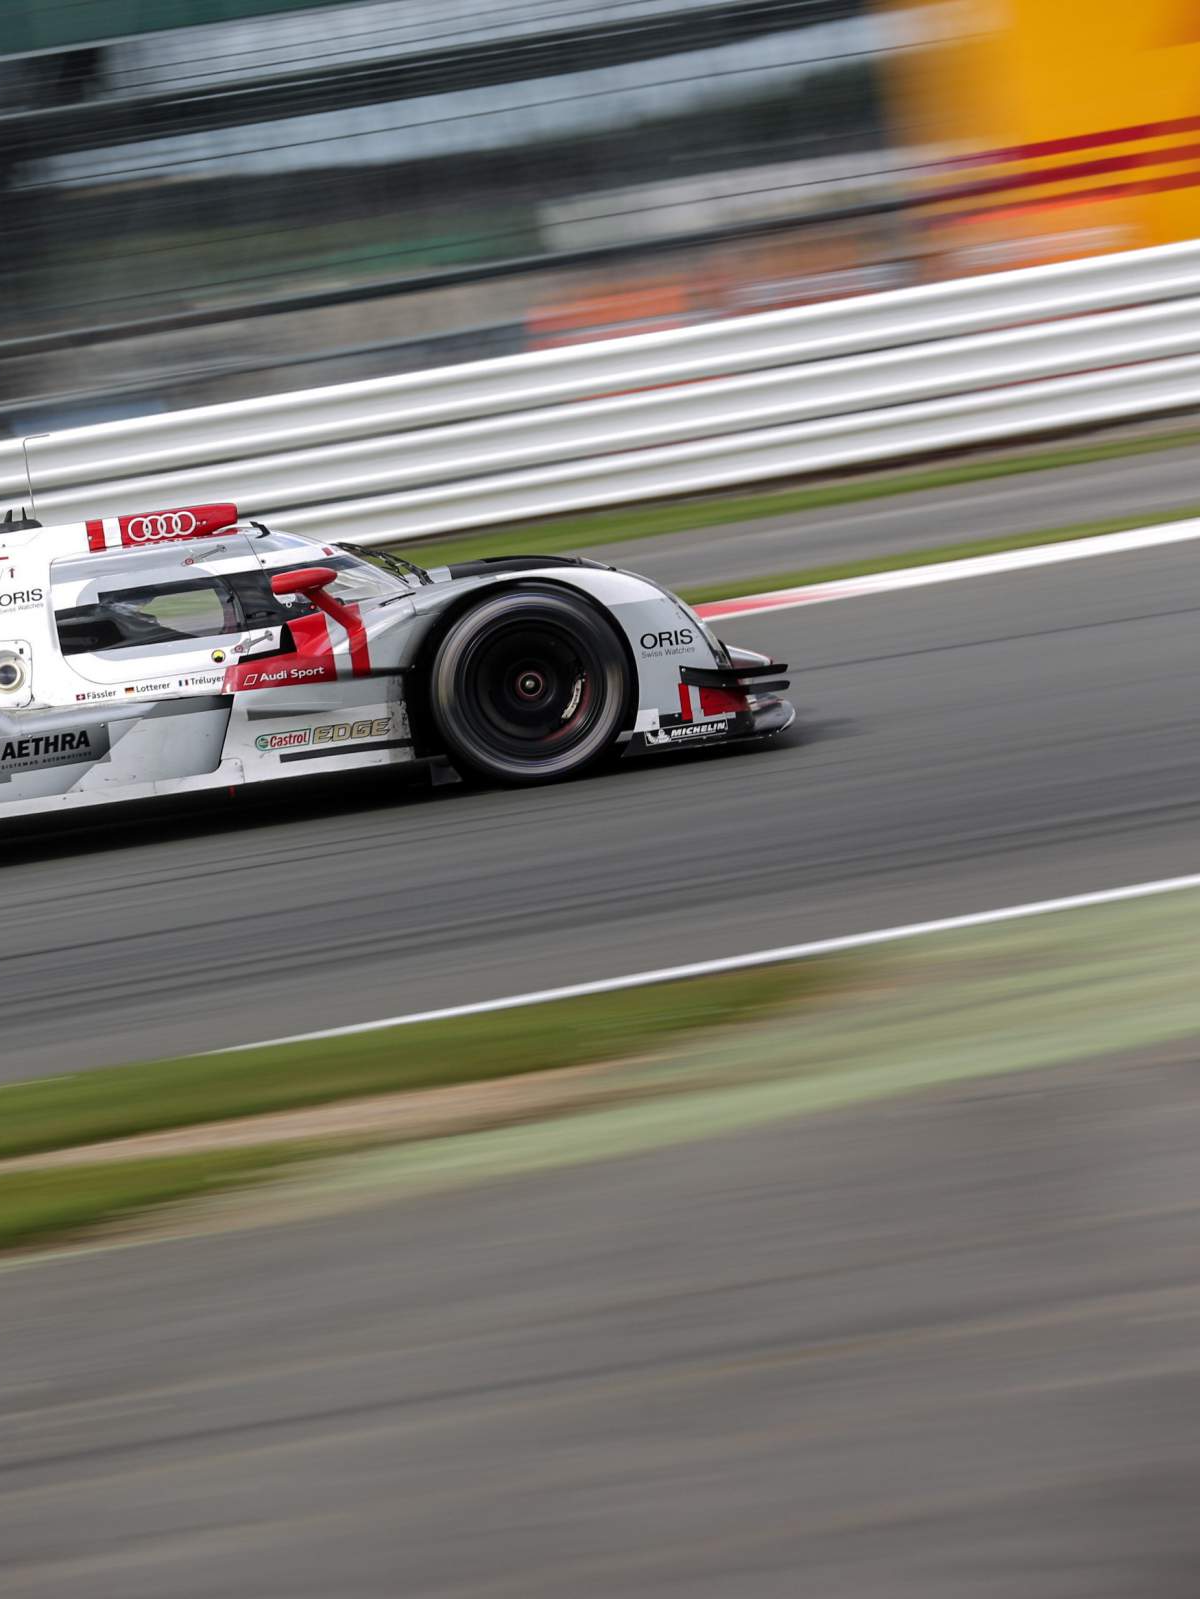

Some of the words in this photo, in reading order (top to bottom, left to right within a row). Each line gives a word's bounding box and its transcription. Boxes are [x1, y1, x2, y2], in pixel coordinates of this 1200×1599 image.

[640, 628, 693, 650] ORIS
[641, 651, 663, 659] Swiss
[664, 645, 696, 656] Watches
[259, 671, 287, 682] Audi
[290, 666, 324, 679] Sport
[87, 690, 116, 699] Fässler
[136, 682, 170, 692] Lotterer
[269, 731, 308, 748] Castrol
[312, 717, 393, 745] EDGE
[671, 722, 725, 737] MICHELIN
[0, 730, 91, 761] AETHRA
